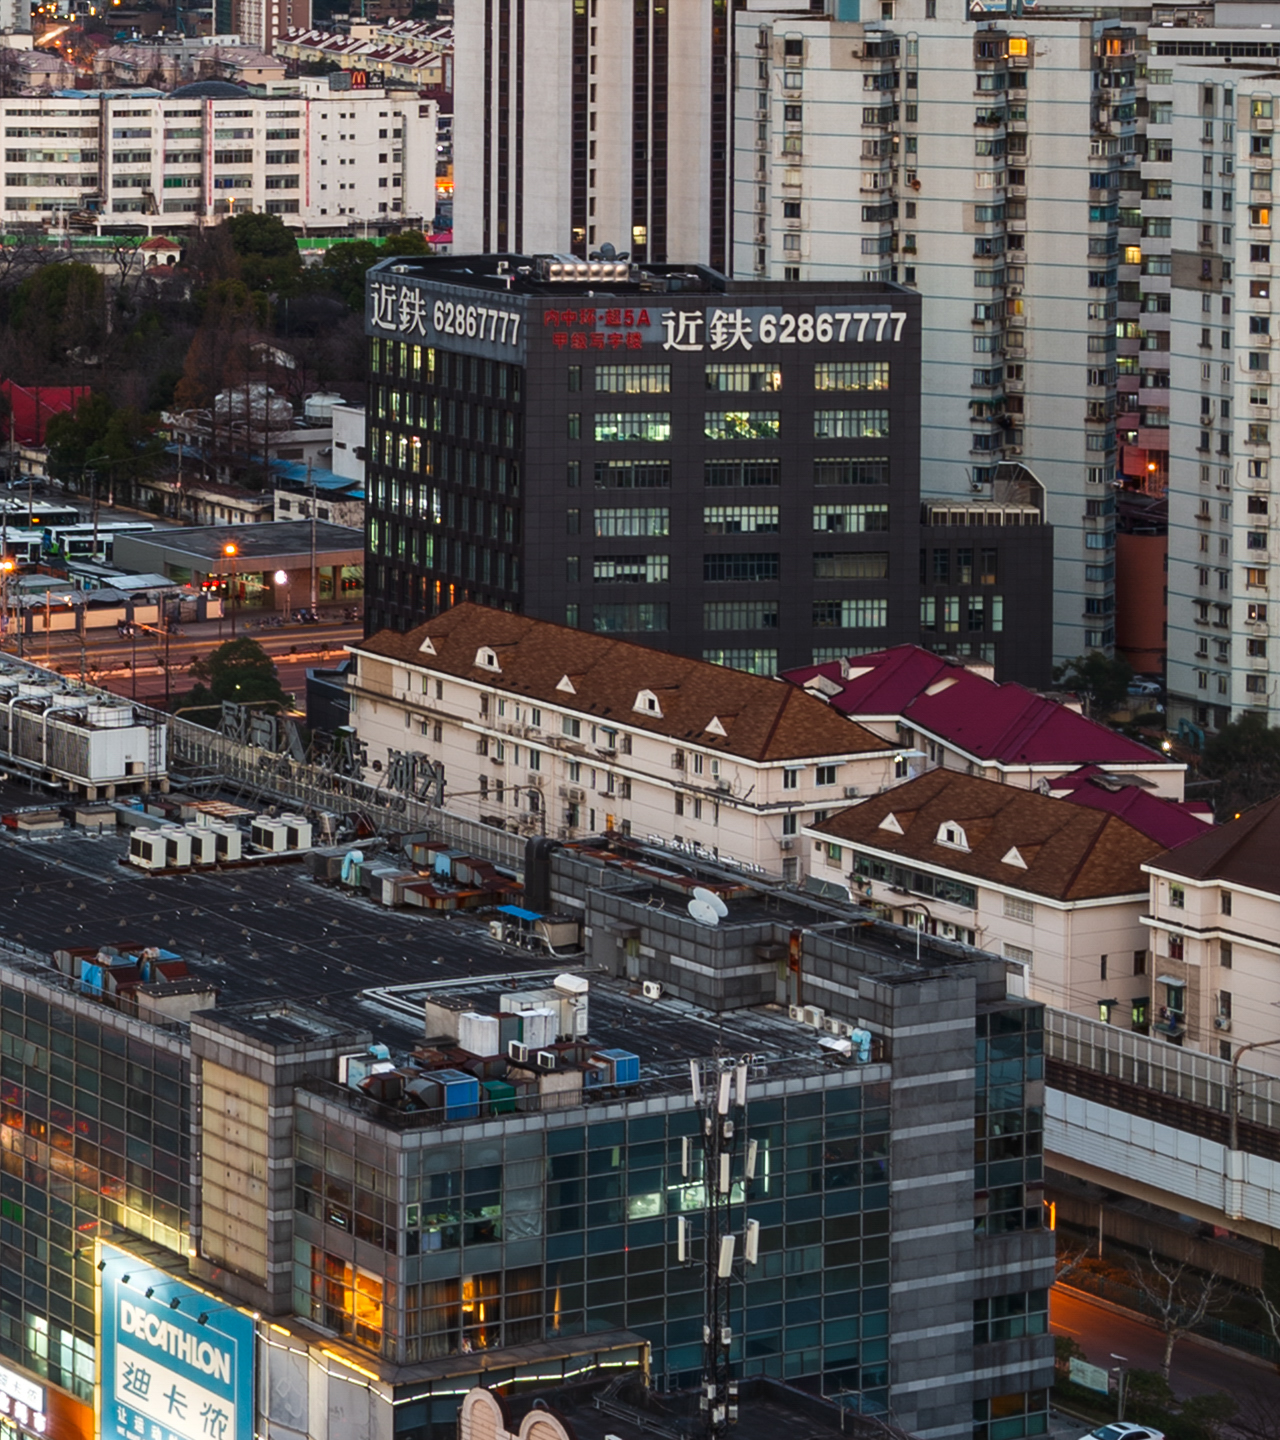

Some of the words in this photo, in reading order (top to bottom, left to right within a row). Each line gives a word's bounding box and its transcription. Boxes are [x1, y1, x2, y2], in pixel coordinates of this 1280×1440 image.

[433, 300, 521, 346] 62867777
[552, 332, 643, 351] 甲级写字楼
[758, 311, 907, 344] 62867777
[120, 1301, 231, 1385] DECATHLON
